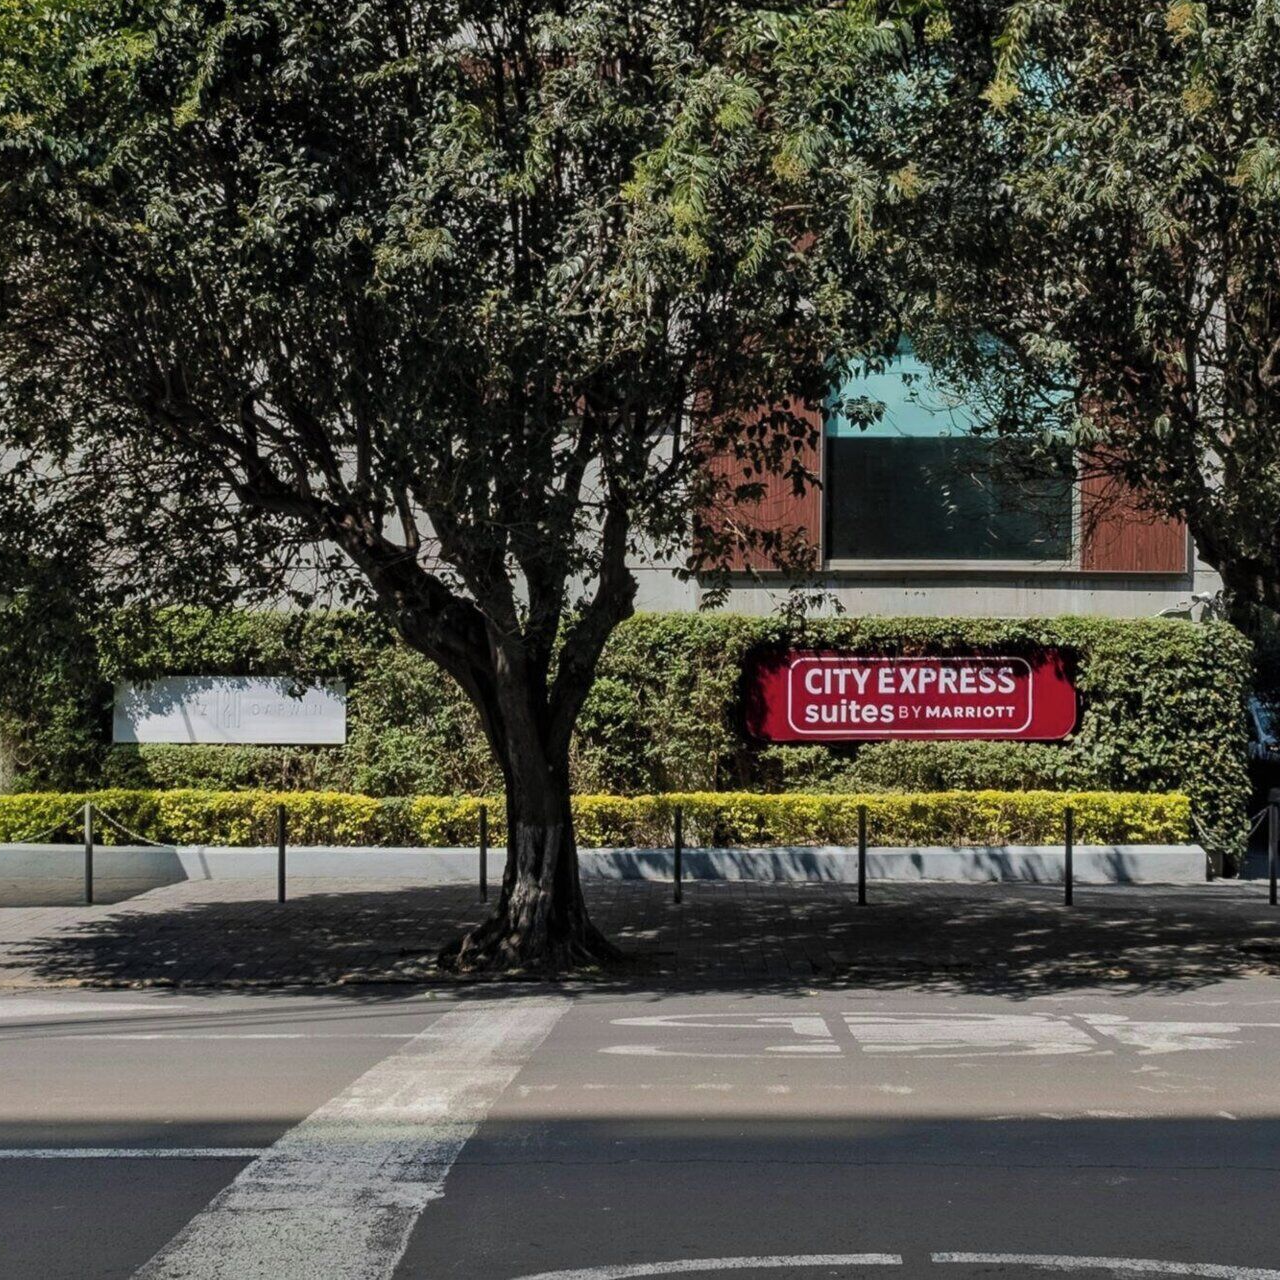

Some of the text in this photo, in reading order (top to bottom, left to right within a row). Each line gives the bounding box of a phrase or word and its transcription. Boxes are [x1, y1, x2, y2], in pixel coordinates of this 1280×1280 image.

[805, 667, 1016, 695] CITY EXPRESS
[805, 699, 1016, 723] suites BY MARRIOTT
